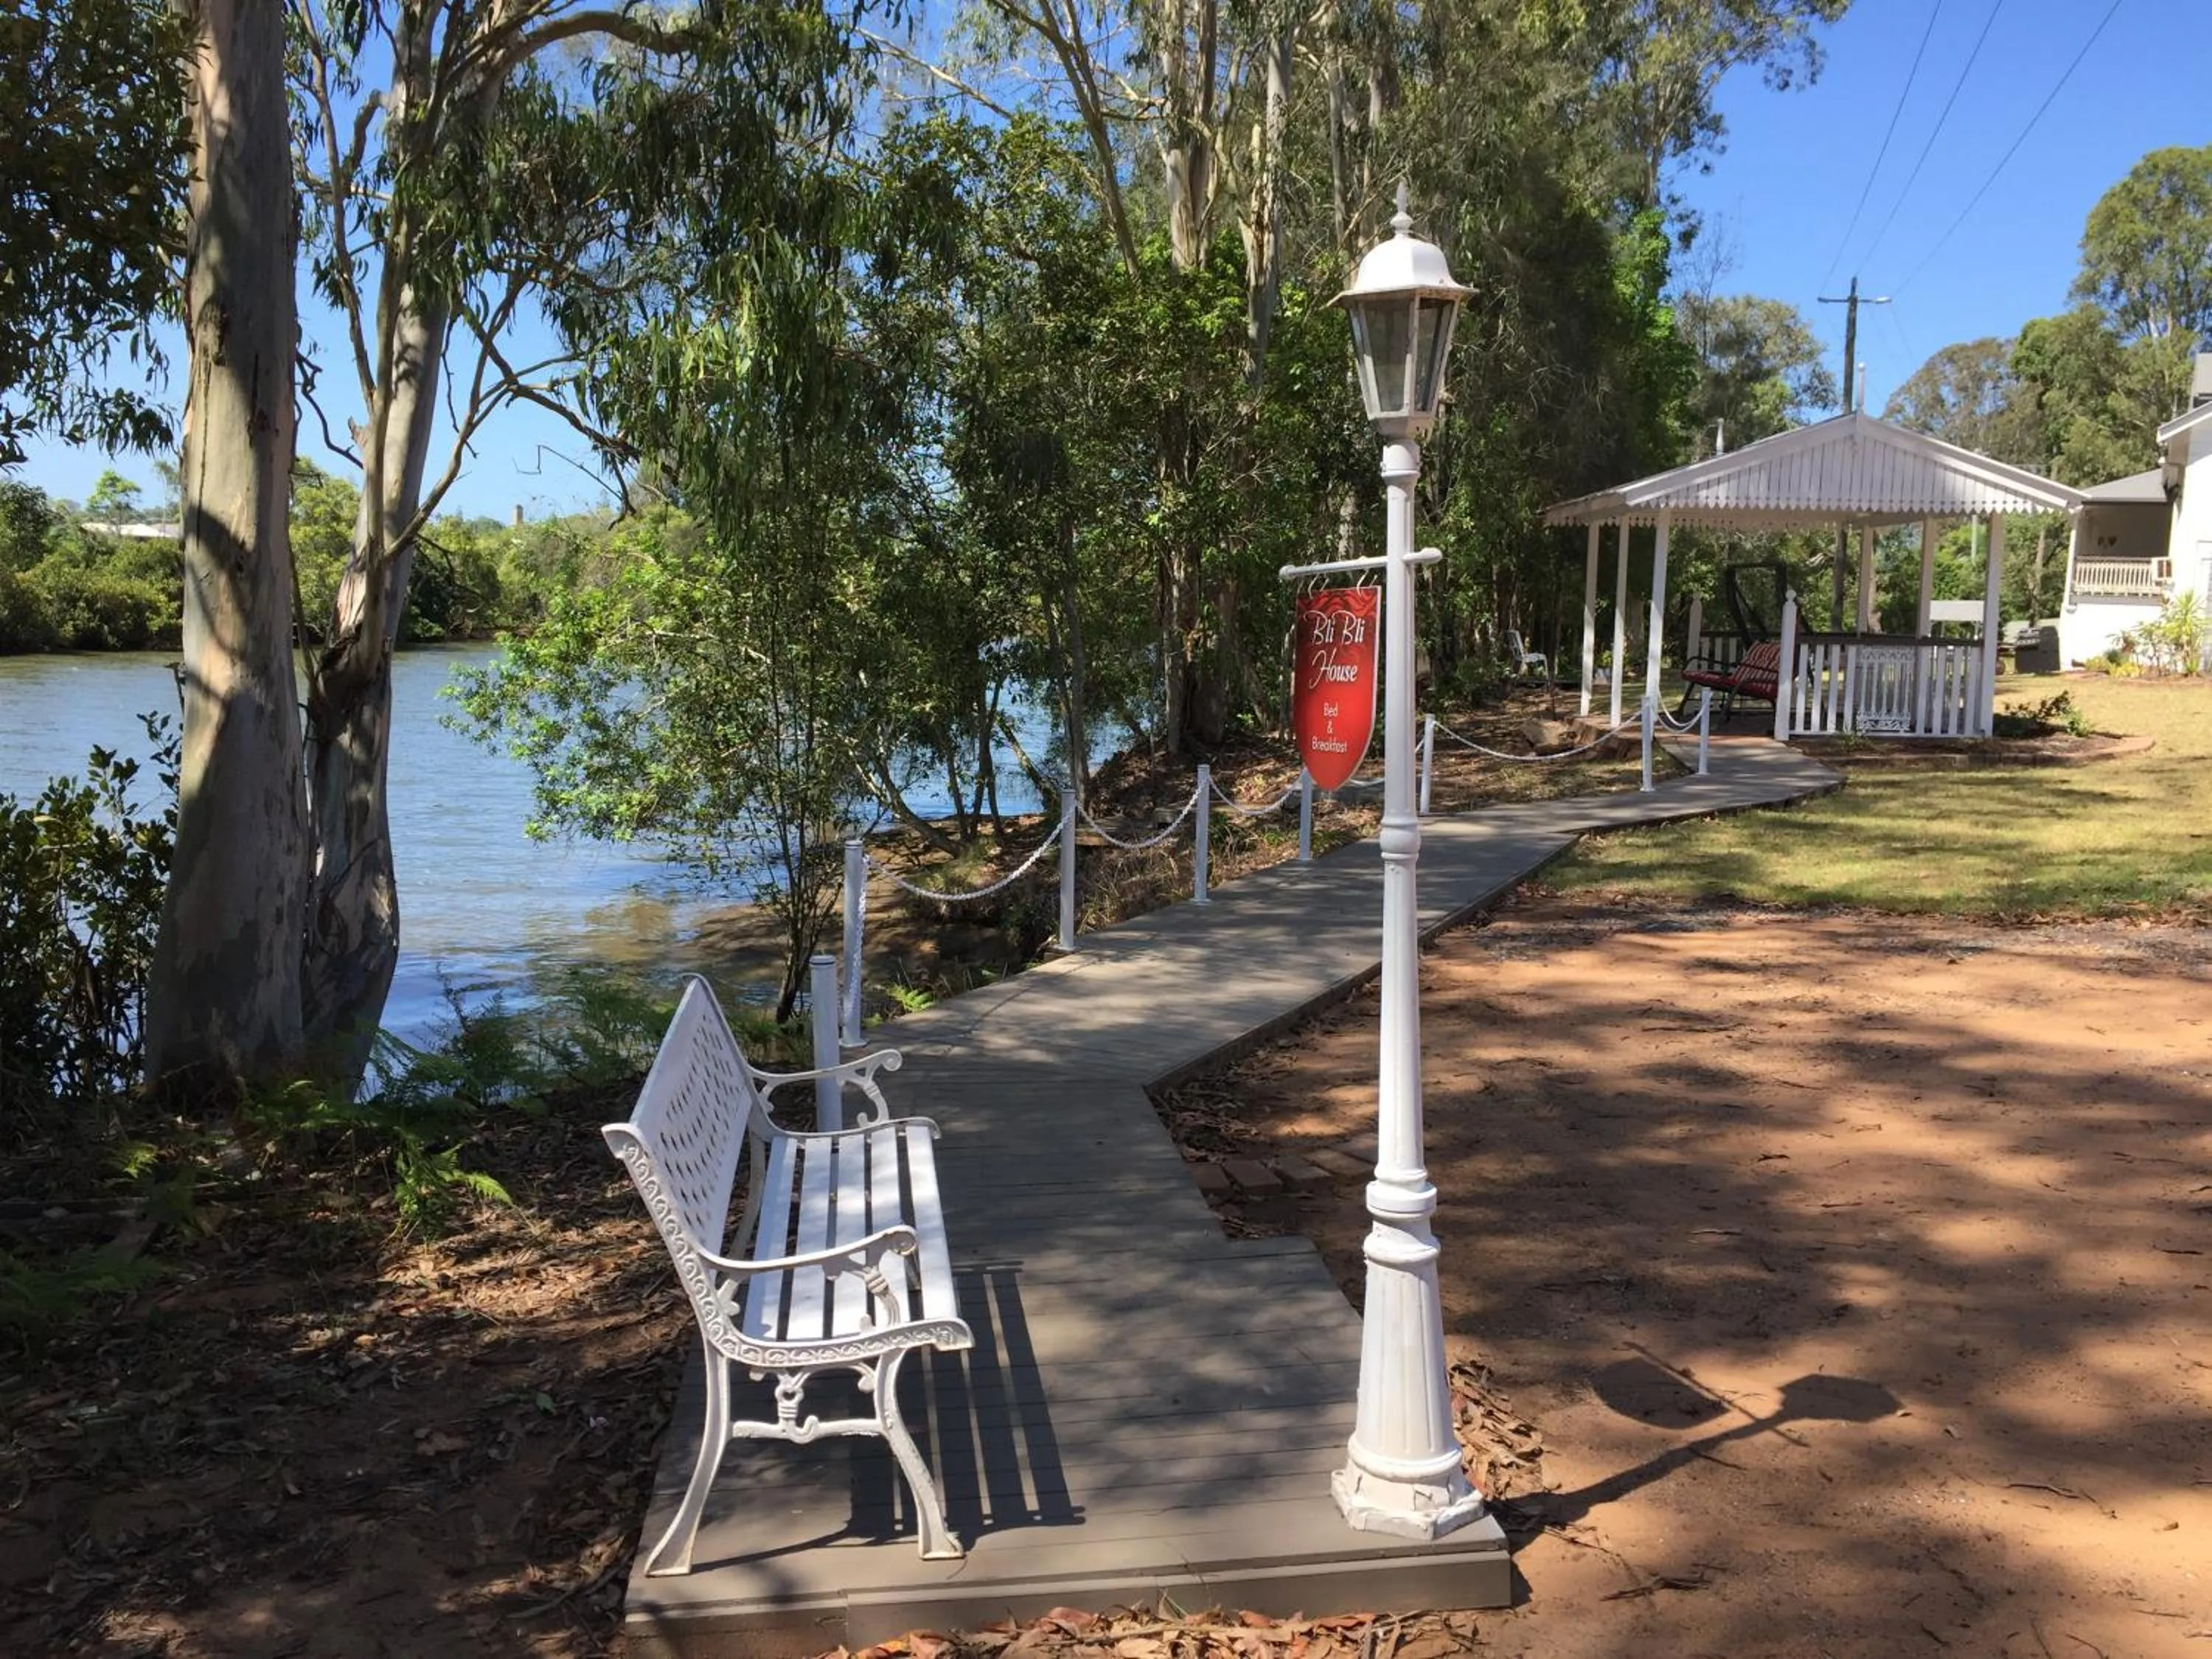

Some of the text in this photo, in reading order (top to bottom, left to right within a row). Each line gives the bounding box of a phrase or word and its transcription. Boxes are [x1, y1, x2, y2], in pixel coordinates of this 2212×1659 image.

[1303, 610, 1365, 645] Bli Bli
[1309, 648, 1357, 689] House
[1324, 702, 1338, 717] Bed
[1327, 720, 1334, 734] &
[1312, 736, 1348, 753] Breakfast
